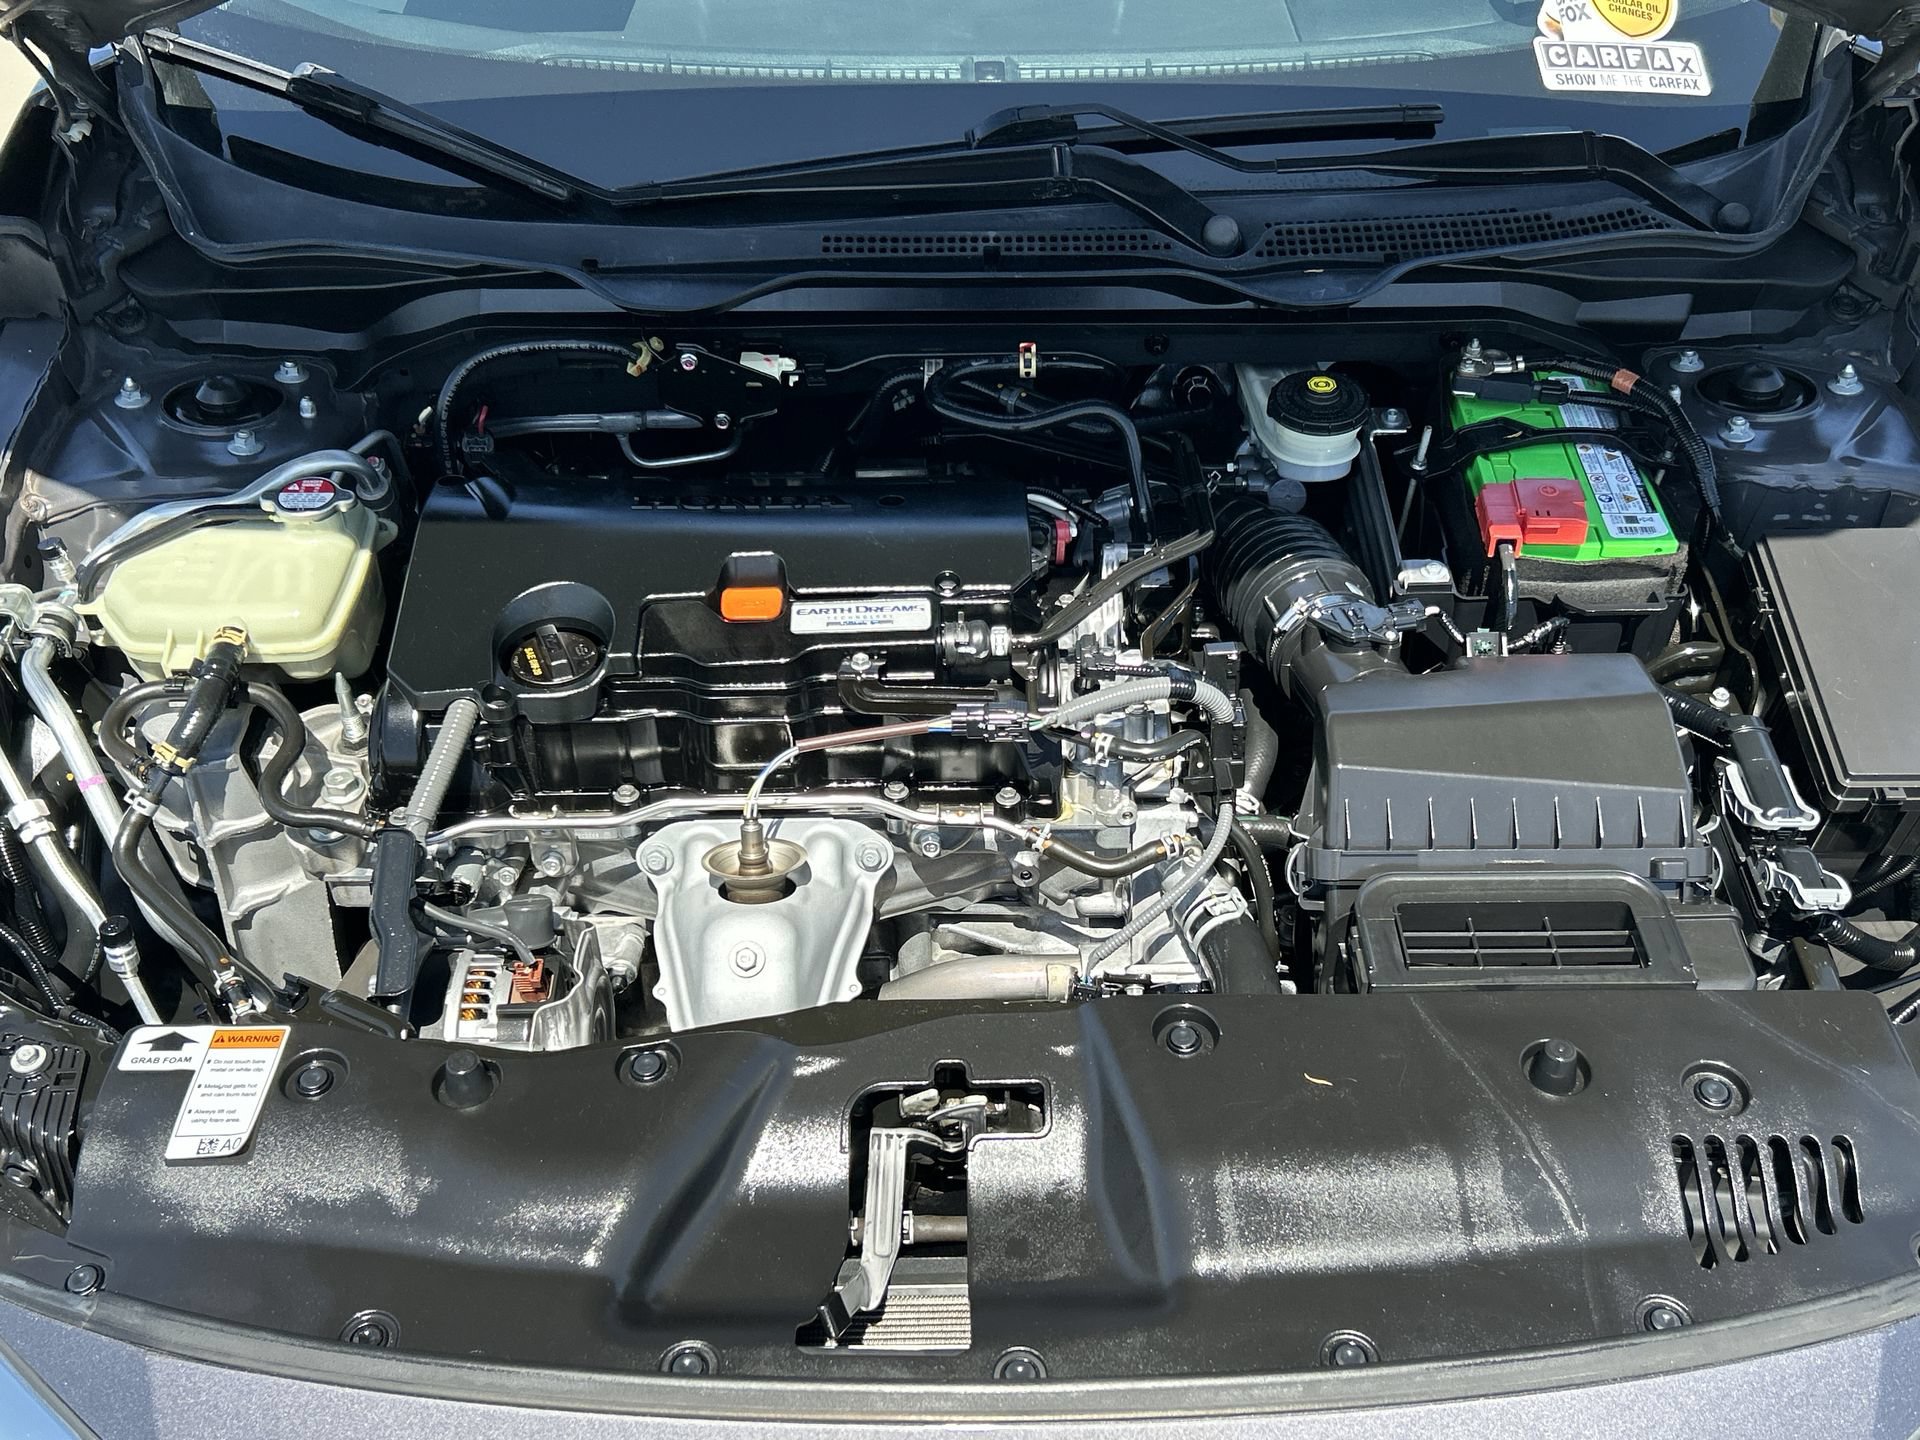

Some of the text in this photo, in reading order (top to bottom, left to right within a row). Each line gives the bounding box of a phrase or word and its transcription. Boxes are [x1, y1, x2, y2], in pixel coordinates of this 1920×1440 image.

[1559, 3, 1592, 25] FOX
[1608, 3, 1653, 21] CHANGES
[1645, 3, 1661, 14] OIL
[1544, 44, 1696, 74] CARFAX
[1555, 73, 1596, 86] SHOW
[1649, 76, 1700, 90] CARFAX
[796, 607, 852, 616] EARTH
[227, 1035, 280, 1043] WARNING
[130, 1056, 192, 1064] GRAB FOAM
[219, 1137, 242, 1152] A0
